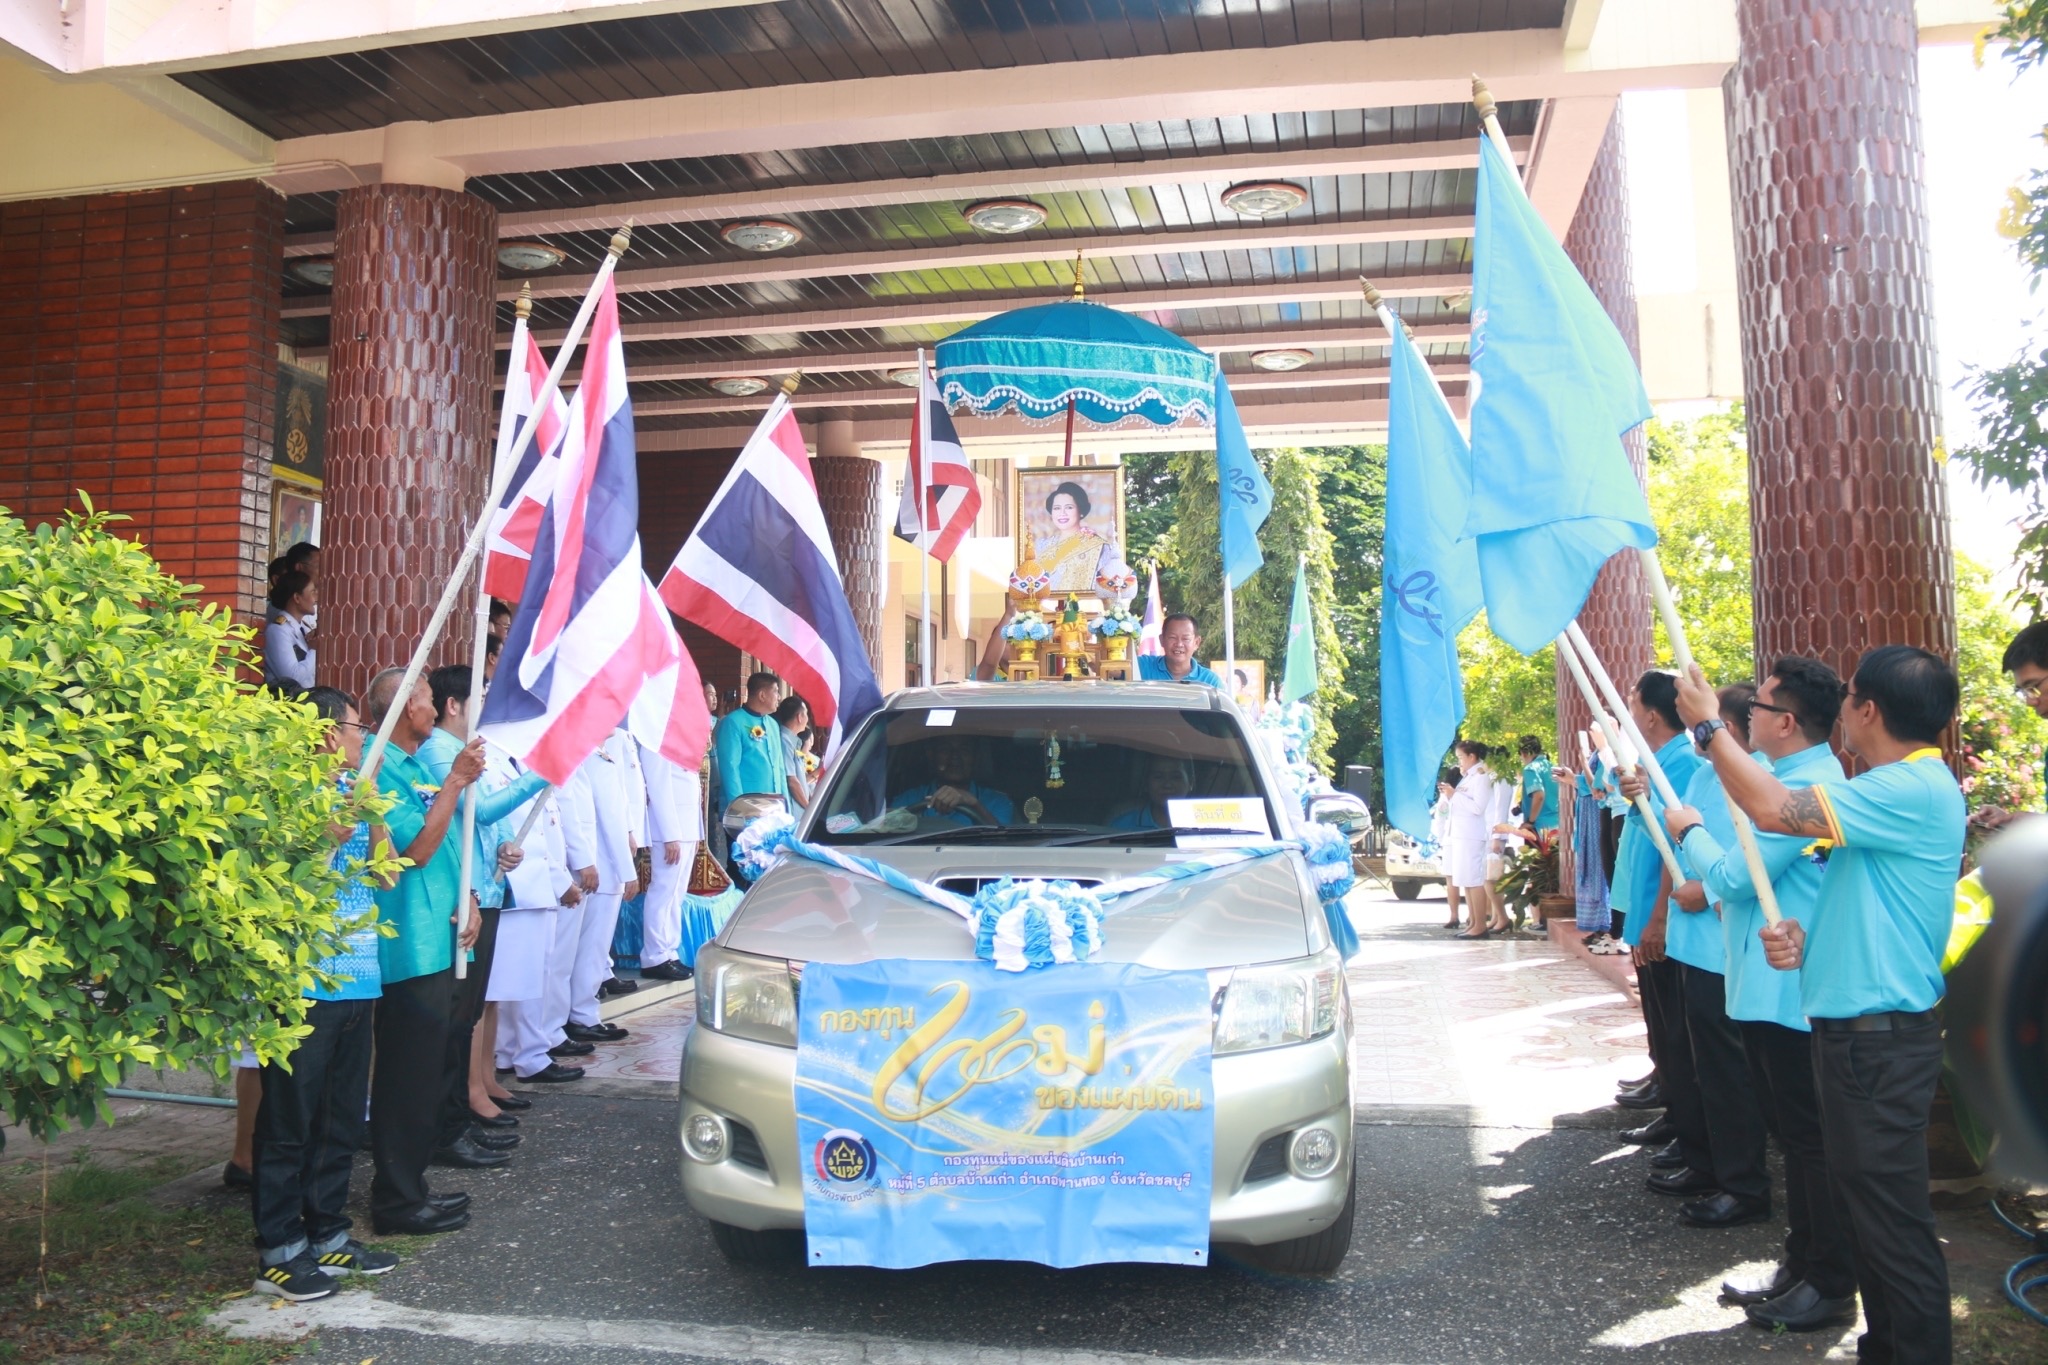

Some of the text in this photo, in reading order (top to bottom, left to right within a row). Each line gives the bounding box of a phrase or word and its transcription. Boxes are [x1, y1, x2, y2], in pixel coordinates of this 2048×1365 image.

[820, 1006, 916, 1041] กองทุน
[1035, 1064, 1204, 1111] ของแผ่นดิน
[943, 1151, 1125, 1170] กองทุนแม่ของแผ่นดินบ้านเก่า
[888, 1170, 1192, 1194] หมู่ที่ 5 ตำบลบ้านเก่า อำเภอพานทอง จังหวัดชลบุรี
